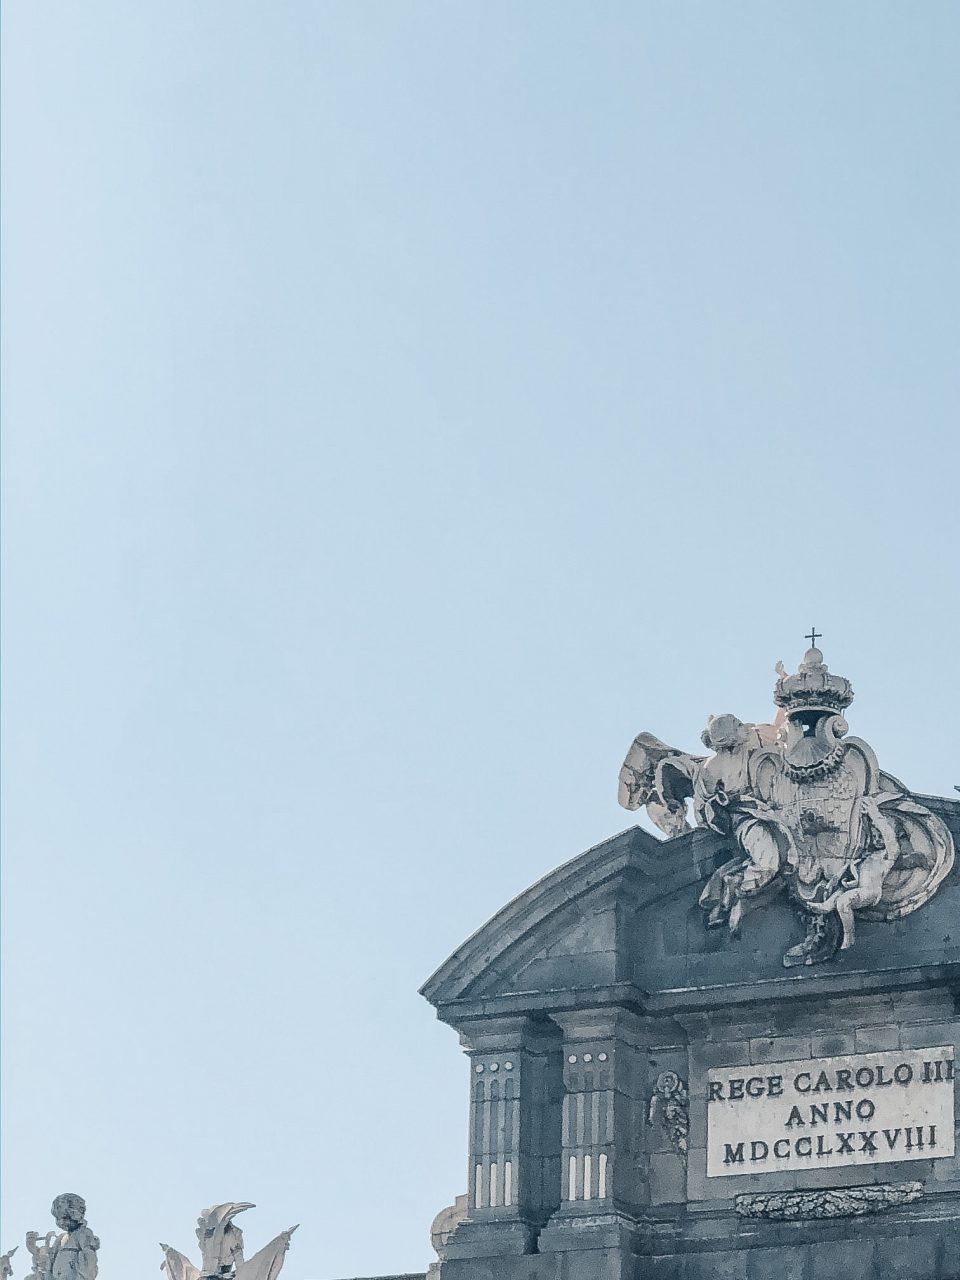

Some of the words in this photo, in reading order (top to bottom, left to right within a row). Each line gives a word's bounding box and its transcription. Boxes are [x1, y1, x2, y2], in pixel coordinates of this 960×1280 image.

[706, 1075, 784, 1102] REGE
[793, 1064, 913, 1092] CAROLO
[922, 1060, 955, 1083] III
[785, 1099, 875, 1126] ANNO
[723, 1126, 937, 1163] MDCCLXXVIII
